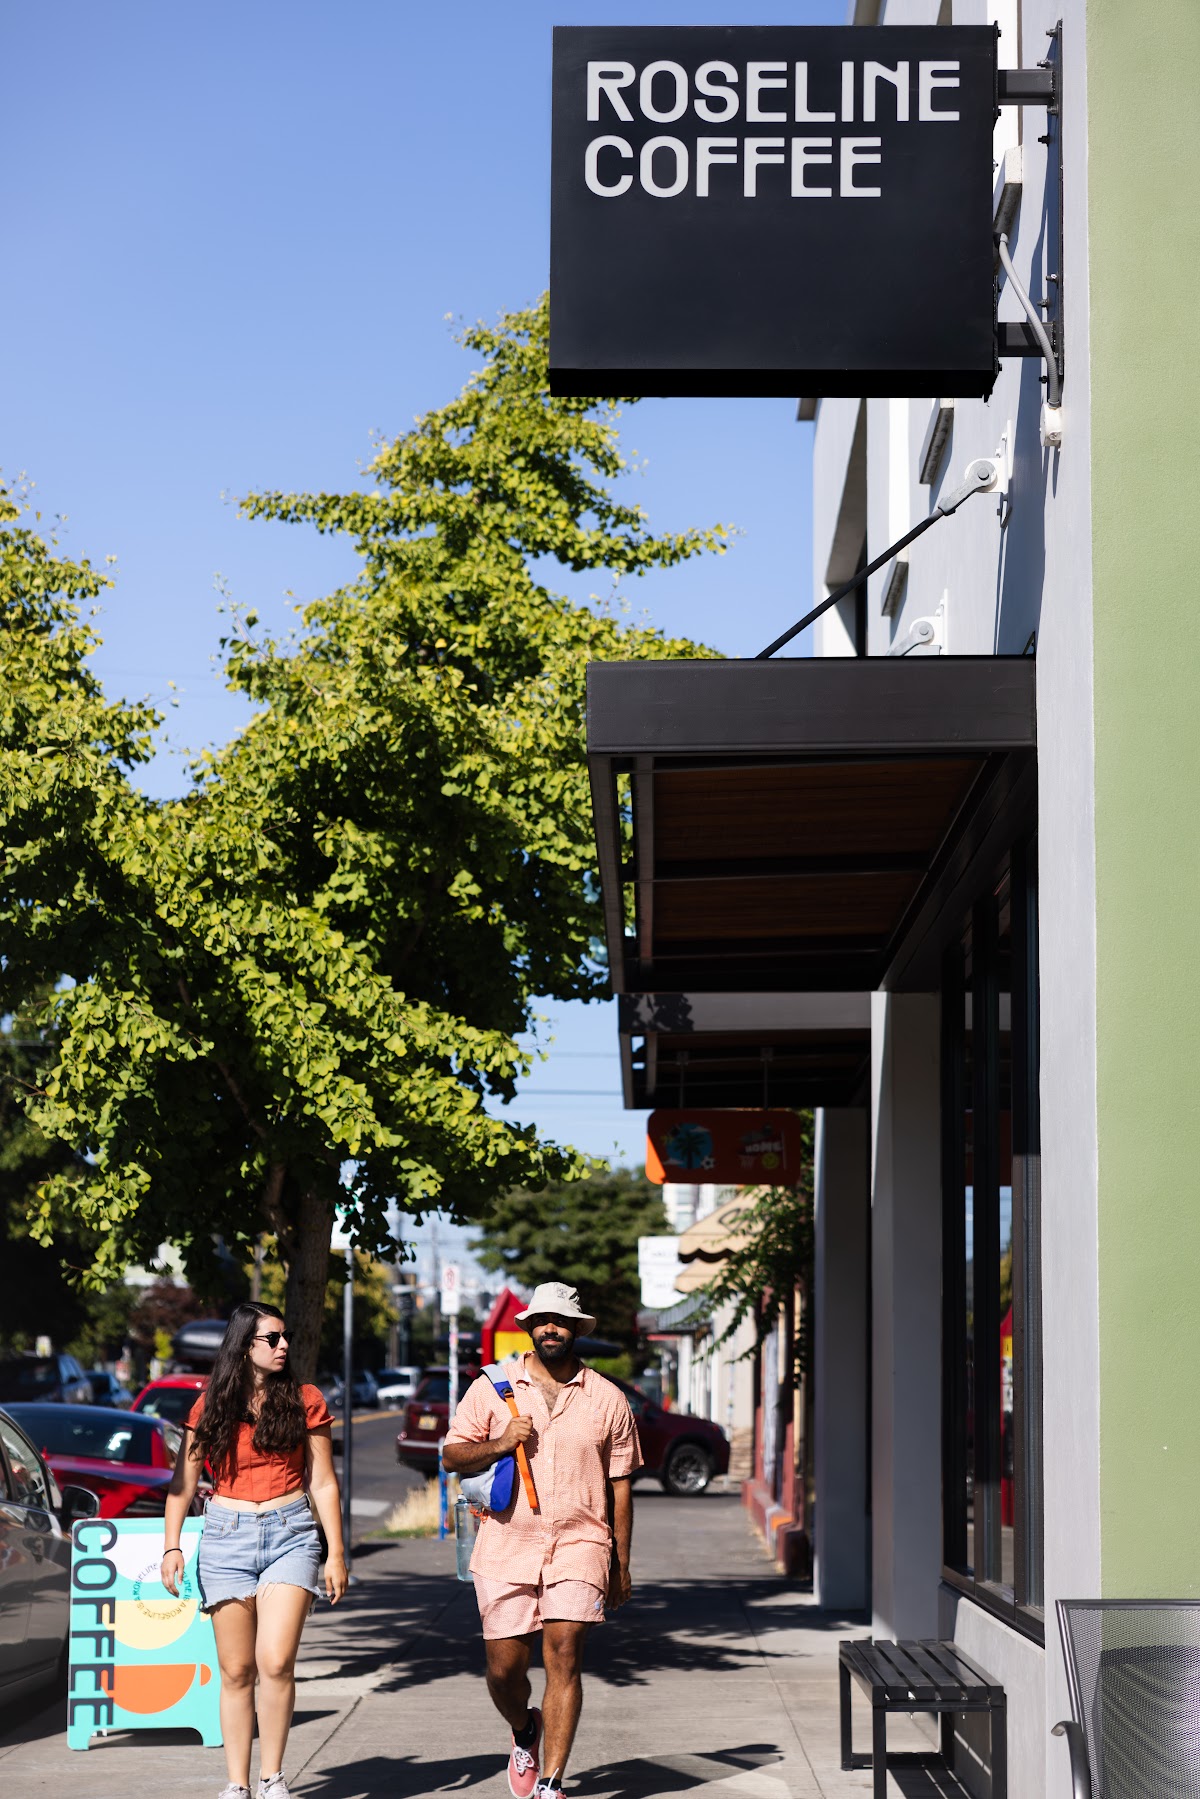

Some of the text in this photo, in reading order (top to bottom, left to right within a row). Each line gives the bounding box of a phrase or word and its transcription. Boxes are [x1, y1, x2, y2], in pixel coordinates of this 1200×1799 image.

[587, 60, 960, 122] ROSELINE
[585, 135, 882, 197] COFFEE
[70, 1521, 118, 1726] COFFEE
